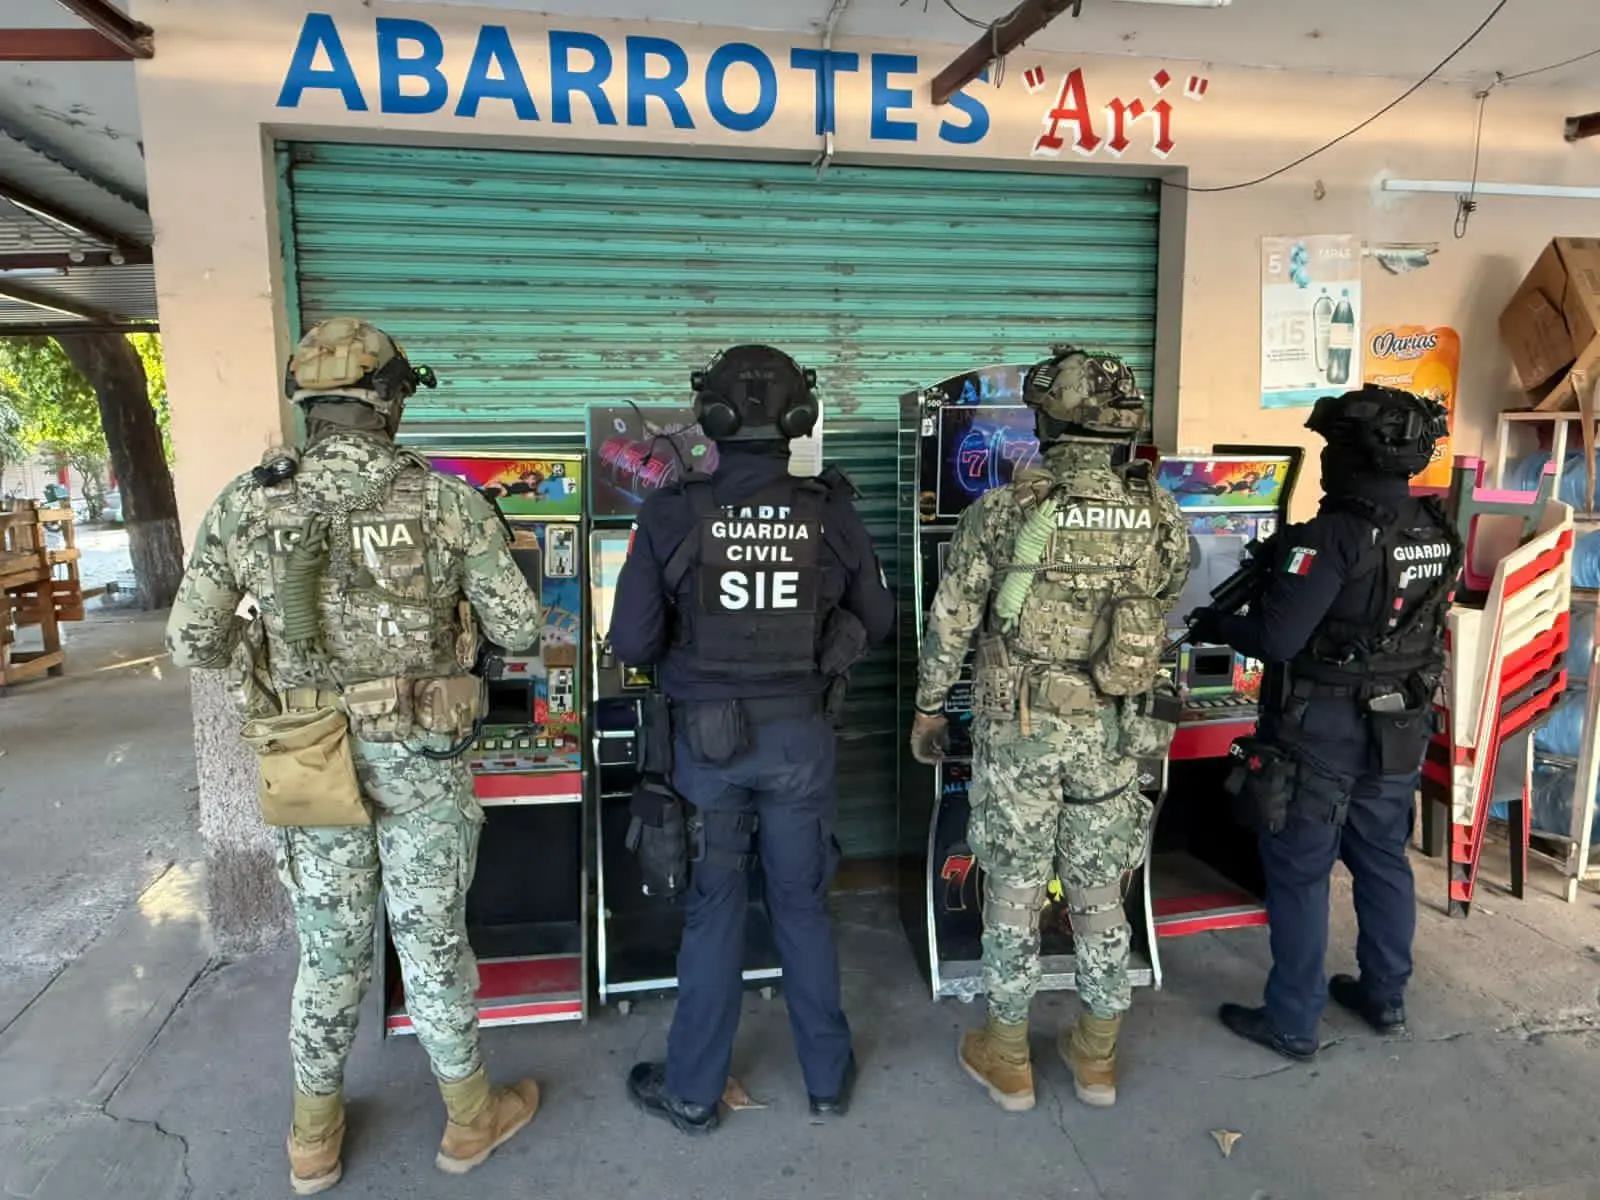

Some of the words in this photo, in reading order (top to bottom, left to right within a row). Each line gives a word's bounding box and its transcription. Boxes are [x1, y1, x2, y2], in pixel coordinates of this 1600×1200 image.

[276, 13, 990, 145] ABARROTES
[1022, 65, 1209, 159] "Ari"
[711, 521, 809, 540] GUARDIA
[726, 545, 794, 562] CIVIL
[719, 570, 800, 610] SIE
